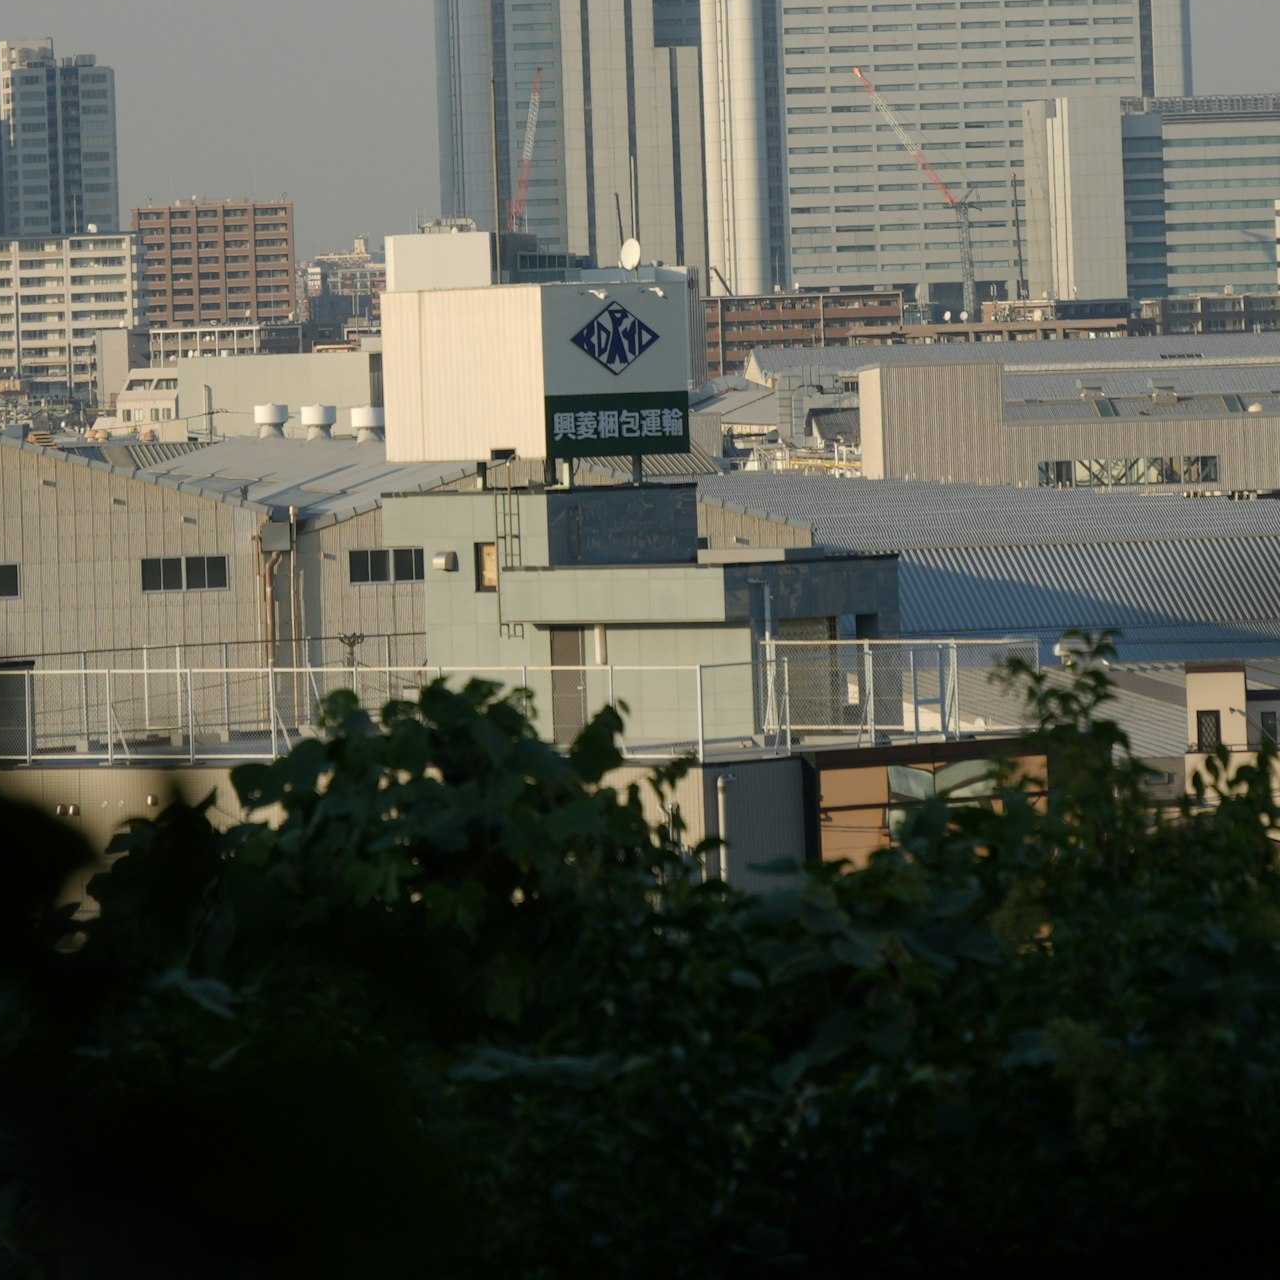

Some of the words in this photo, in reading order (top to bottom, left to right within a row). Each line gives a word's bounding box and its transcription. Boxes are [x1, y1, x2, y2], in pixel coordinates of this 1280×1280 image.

[553, 408, 683, 442] 興菱梱包運輸
